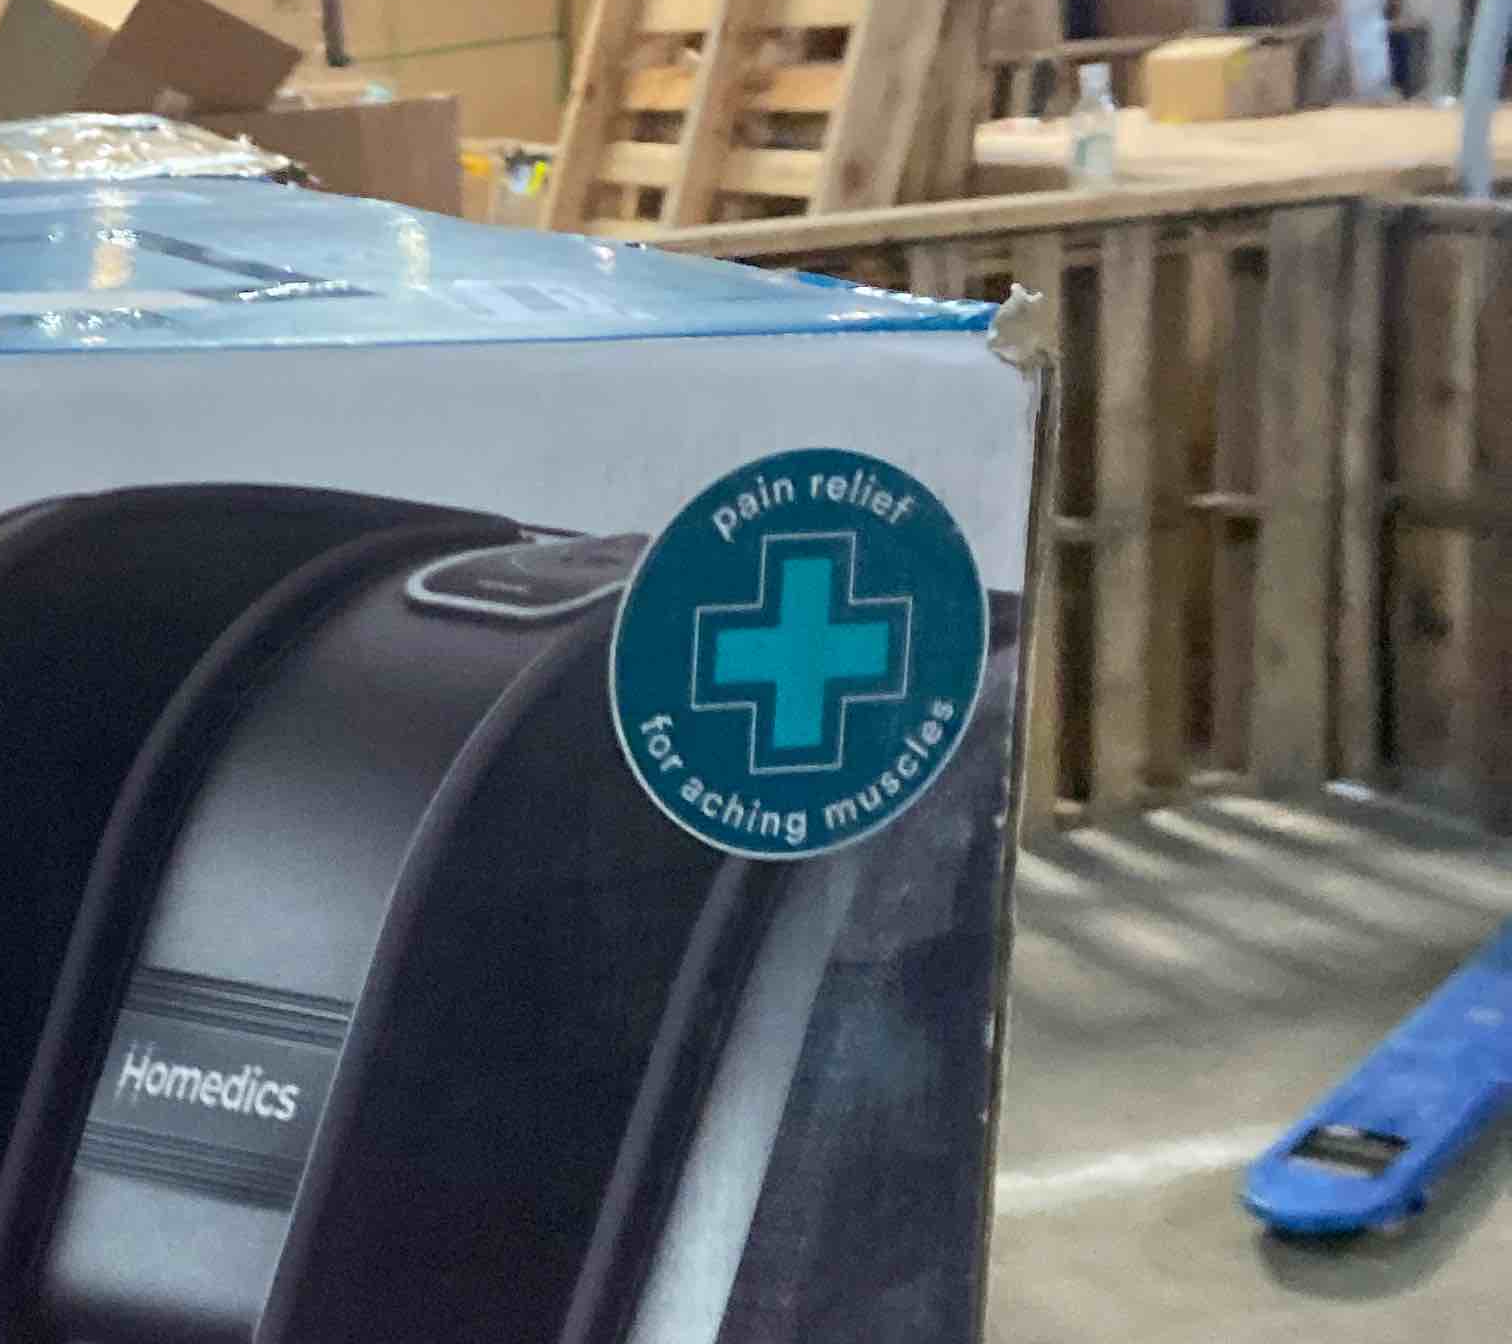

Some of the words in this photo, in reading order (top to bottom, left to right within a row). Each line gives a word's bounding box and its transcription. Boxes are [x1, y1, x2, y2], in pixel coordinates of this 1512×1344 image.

[712, 476, 795, 542] pain
[809, 470, 915, 524] relief
[641, 713, 685, 774] for
[680, 776, 808, 846] aching
[823, 697, 956, 831] muscles
[113, 1042, 301, 1123] Homedics
